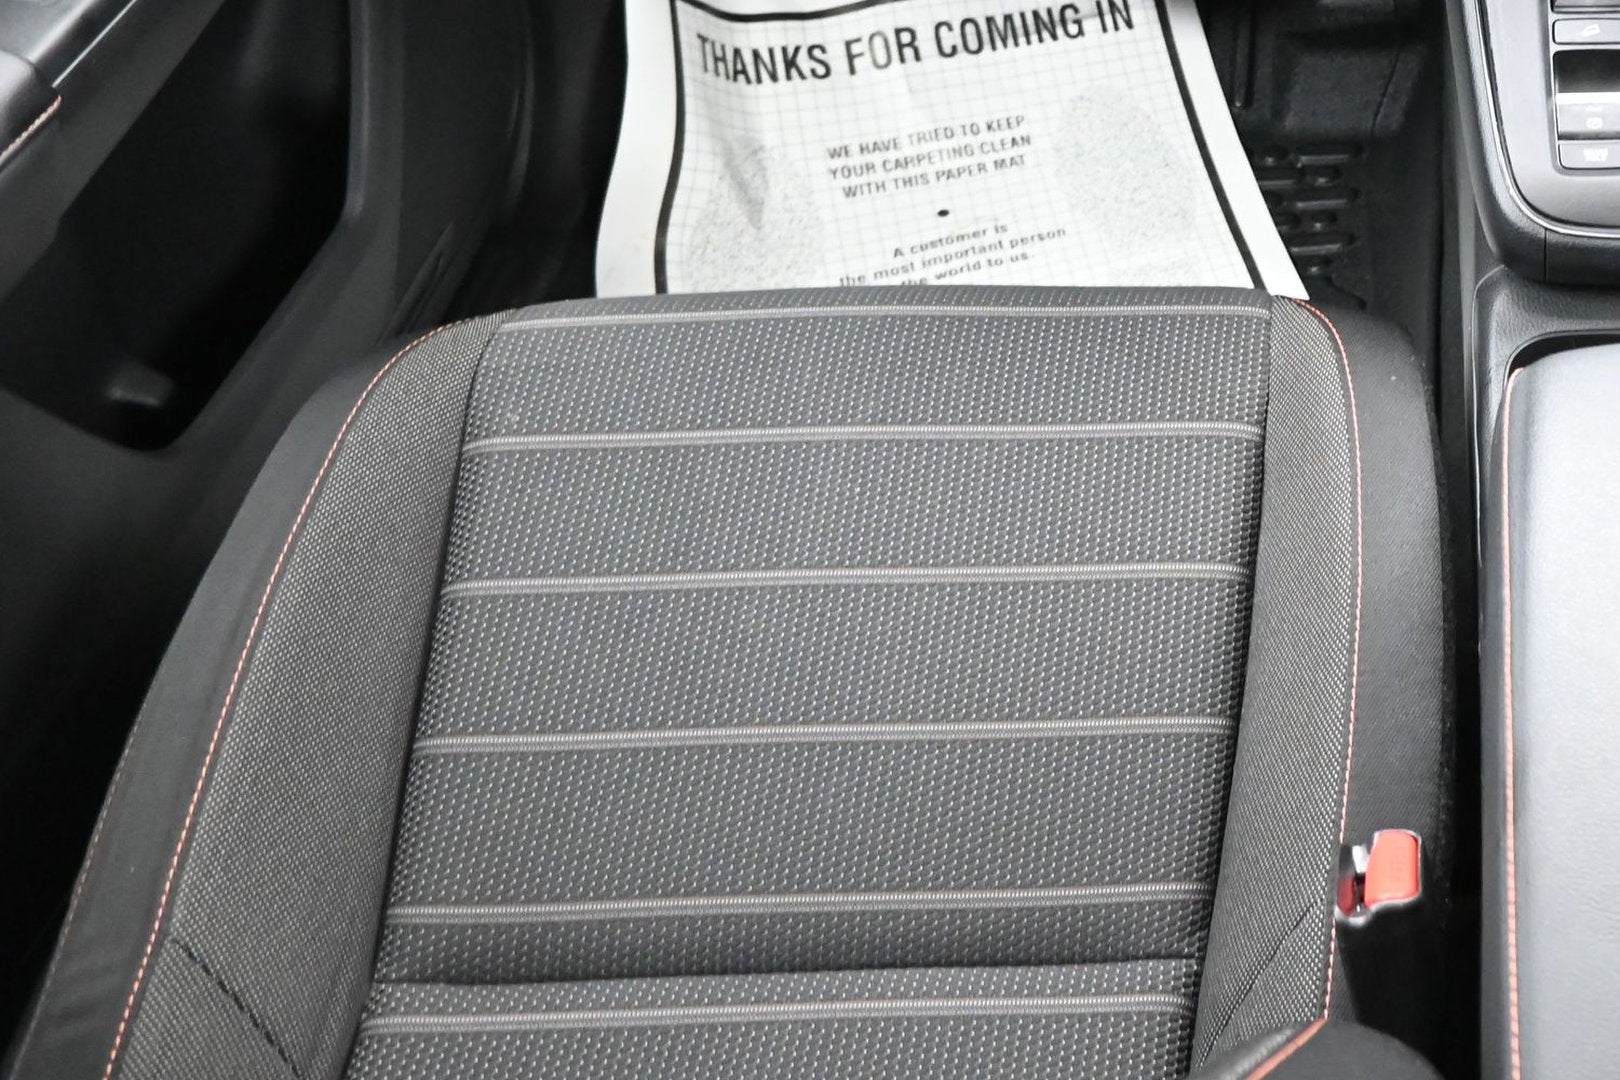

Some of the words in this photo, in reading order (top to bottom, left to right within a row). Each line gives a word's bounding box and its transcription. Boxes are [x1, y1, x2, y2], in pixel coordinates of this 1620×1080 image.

[697, 32, 832, 86] THANKS
[845, 27, 922, 76] FOR
[934, 3, 1085, 59] COMING
[827, 144, 851, 160] WE
[859, 137, 903, 155] HAVE
[908, 126, 954, 146] TRIED
[960, 122, 981, 136] TO
[985, 115, 1025, 133] KEEP
[830, 161, 876, 180] YOUR
[882, 143, 975, 173] CARPETING
[980, 134, 1031, 155] CLEAN
[842, 181, 887, 199] WITH
[893, 171, 930, 191] THIS
[935, 162, 988, 183] PAPER
[993, 154, 1026, 171] MAT
[839, 273, 867, 287] the
[873, 262, 916, 280] most
[922, 240, 1004, 270] important
[1009, 227, 1067, 249] person
[893, 247, 905, 258] A
[910, 227, 988, 255] customer
[994, 223, 1009, 234] is
[934, 259, 982, 281] world
[987, 256, 1004, 268] to
